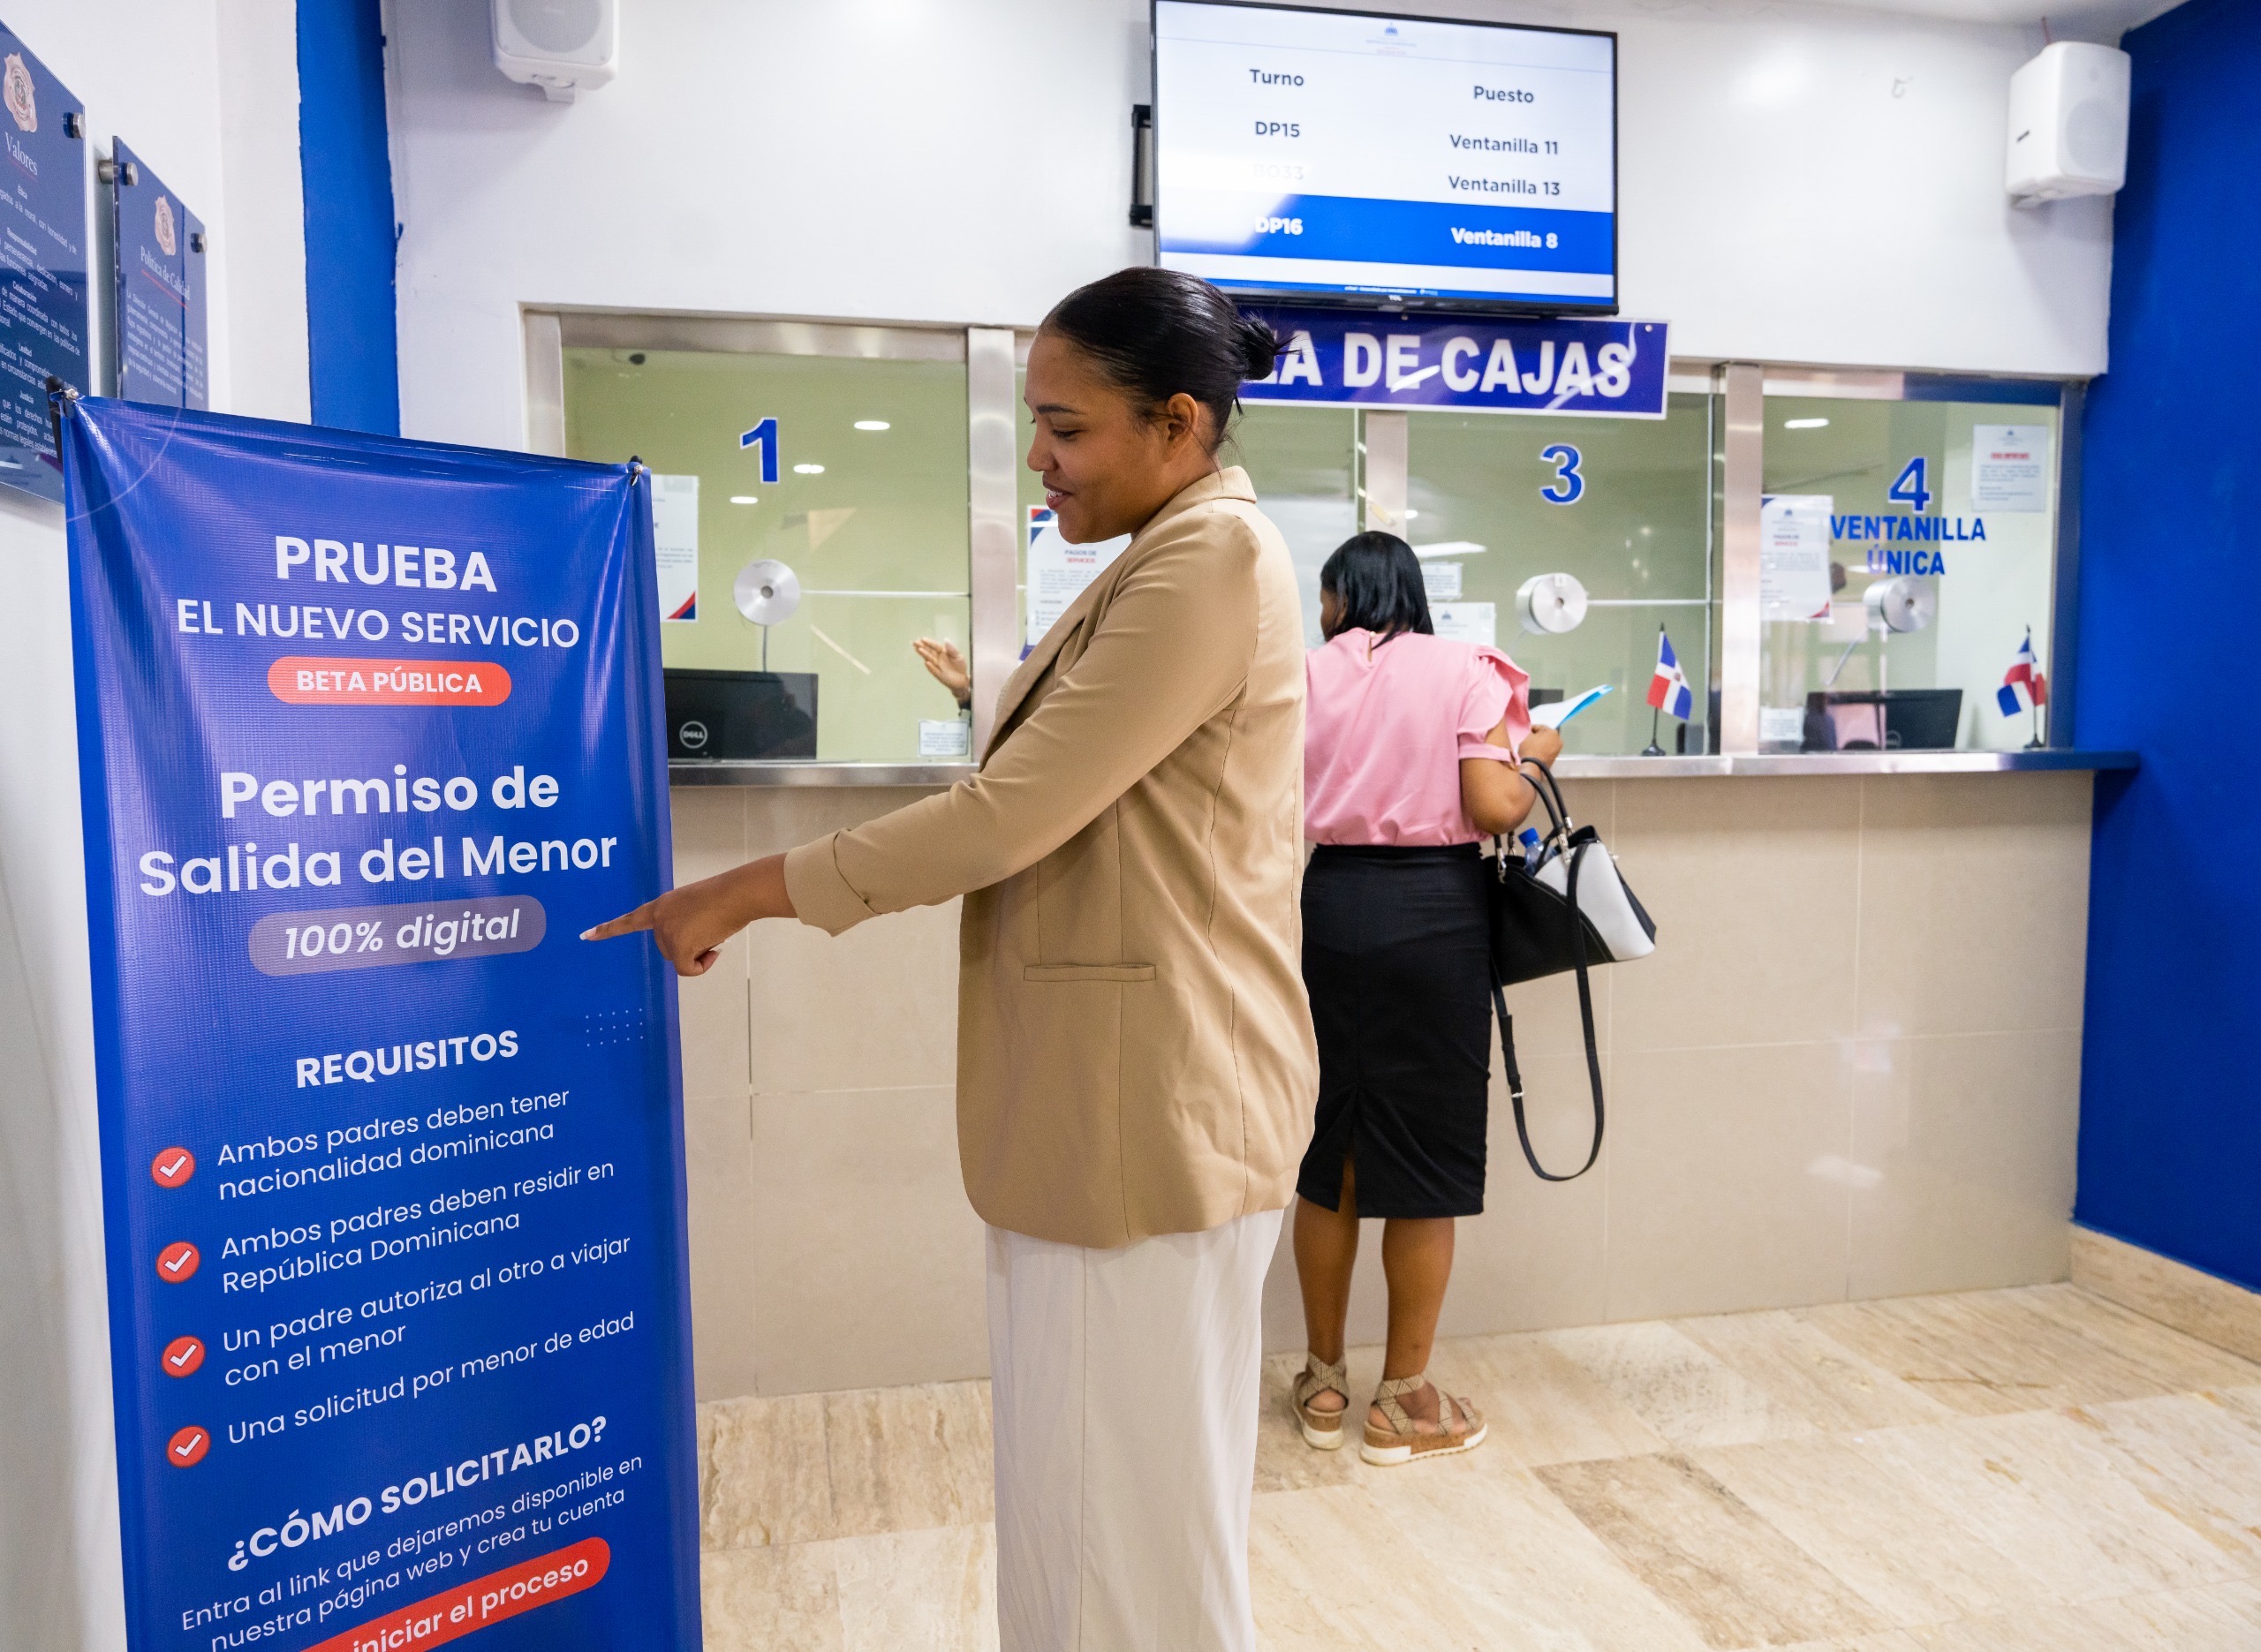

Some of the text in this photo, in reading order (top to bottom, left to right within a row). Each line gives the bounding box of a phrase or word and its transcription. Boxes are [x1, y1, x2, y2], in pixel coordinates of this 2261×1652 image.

[1249, 68, 1304, 87] Turno
[1473, 85, 1534, 104] Puesto
[5, 132, 38, 176] Valores
[1254, 120, 1301, 140] DP15
[1449, 133, 1559, 155] Ventanilla 11
[1448, 175, 1561, 198] Ventanilla 13
[1254, 216, 1304, 236] DP16
[1450, 227, 1559, 250] Ventanilla 8
[1343, 332, 1421, 391] DE
[1441, 336, 1631, 398] CAJAS
[740, 417, 780, 485] 1
[1539, 442, 1586, 506] 3
[1887, 456, 1933, 515] 4
[1829, 513, 1987, 542] VENTANILLA
[275, 535, 498, 592] PRUEBA
[1866, 543, 1947, 577] ÚNICA
[177, 599, 580, 648] EL NUEVO SERVICIO
[297, 666, 483, 693] BETA PÚBLICA
[220, 764, 560, 819] Permiso de
[139, 834, 618, 897] Salida del Menor
[284, 908, 521, 960] 100% digital
[295, 1029, 520, 1089] REQUISITOS
[216, 1087, 571, 1167] Ambos padres deben tener
[218, 1121, 556, 1202] nacionalidad dominicana
[221, 1160, 616, 1260] Ambos padres deben residir en
[222, 1211, 522, 1294] República Dominicana
[223, 1234, 632, 1352] Un padre autoriza al otro a viajar
[223, 1324, 407, 1387] con el menor
[228, 1309, 636, 1445] Una solicitud por menor de edad
[227, 1414, 609, 1573] ¿CÓMO SOLICITARLO?
[181, 1454, 644, 1632] Entra al link que dejaremos disponible en
[210, 1488, 626, 1652] nuestra página web y crea tu cuenta
[449, 1595, 474, 1624] el
[480, 1558, 590, 1610] proceso
